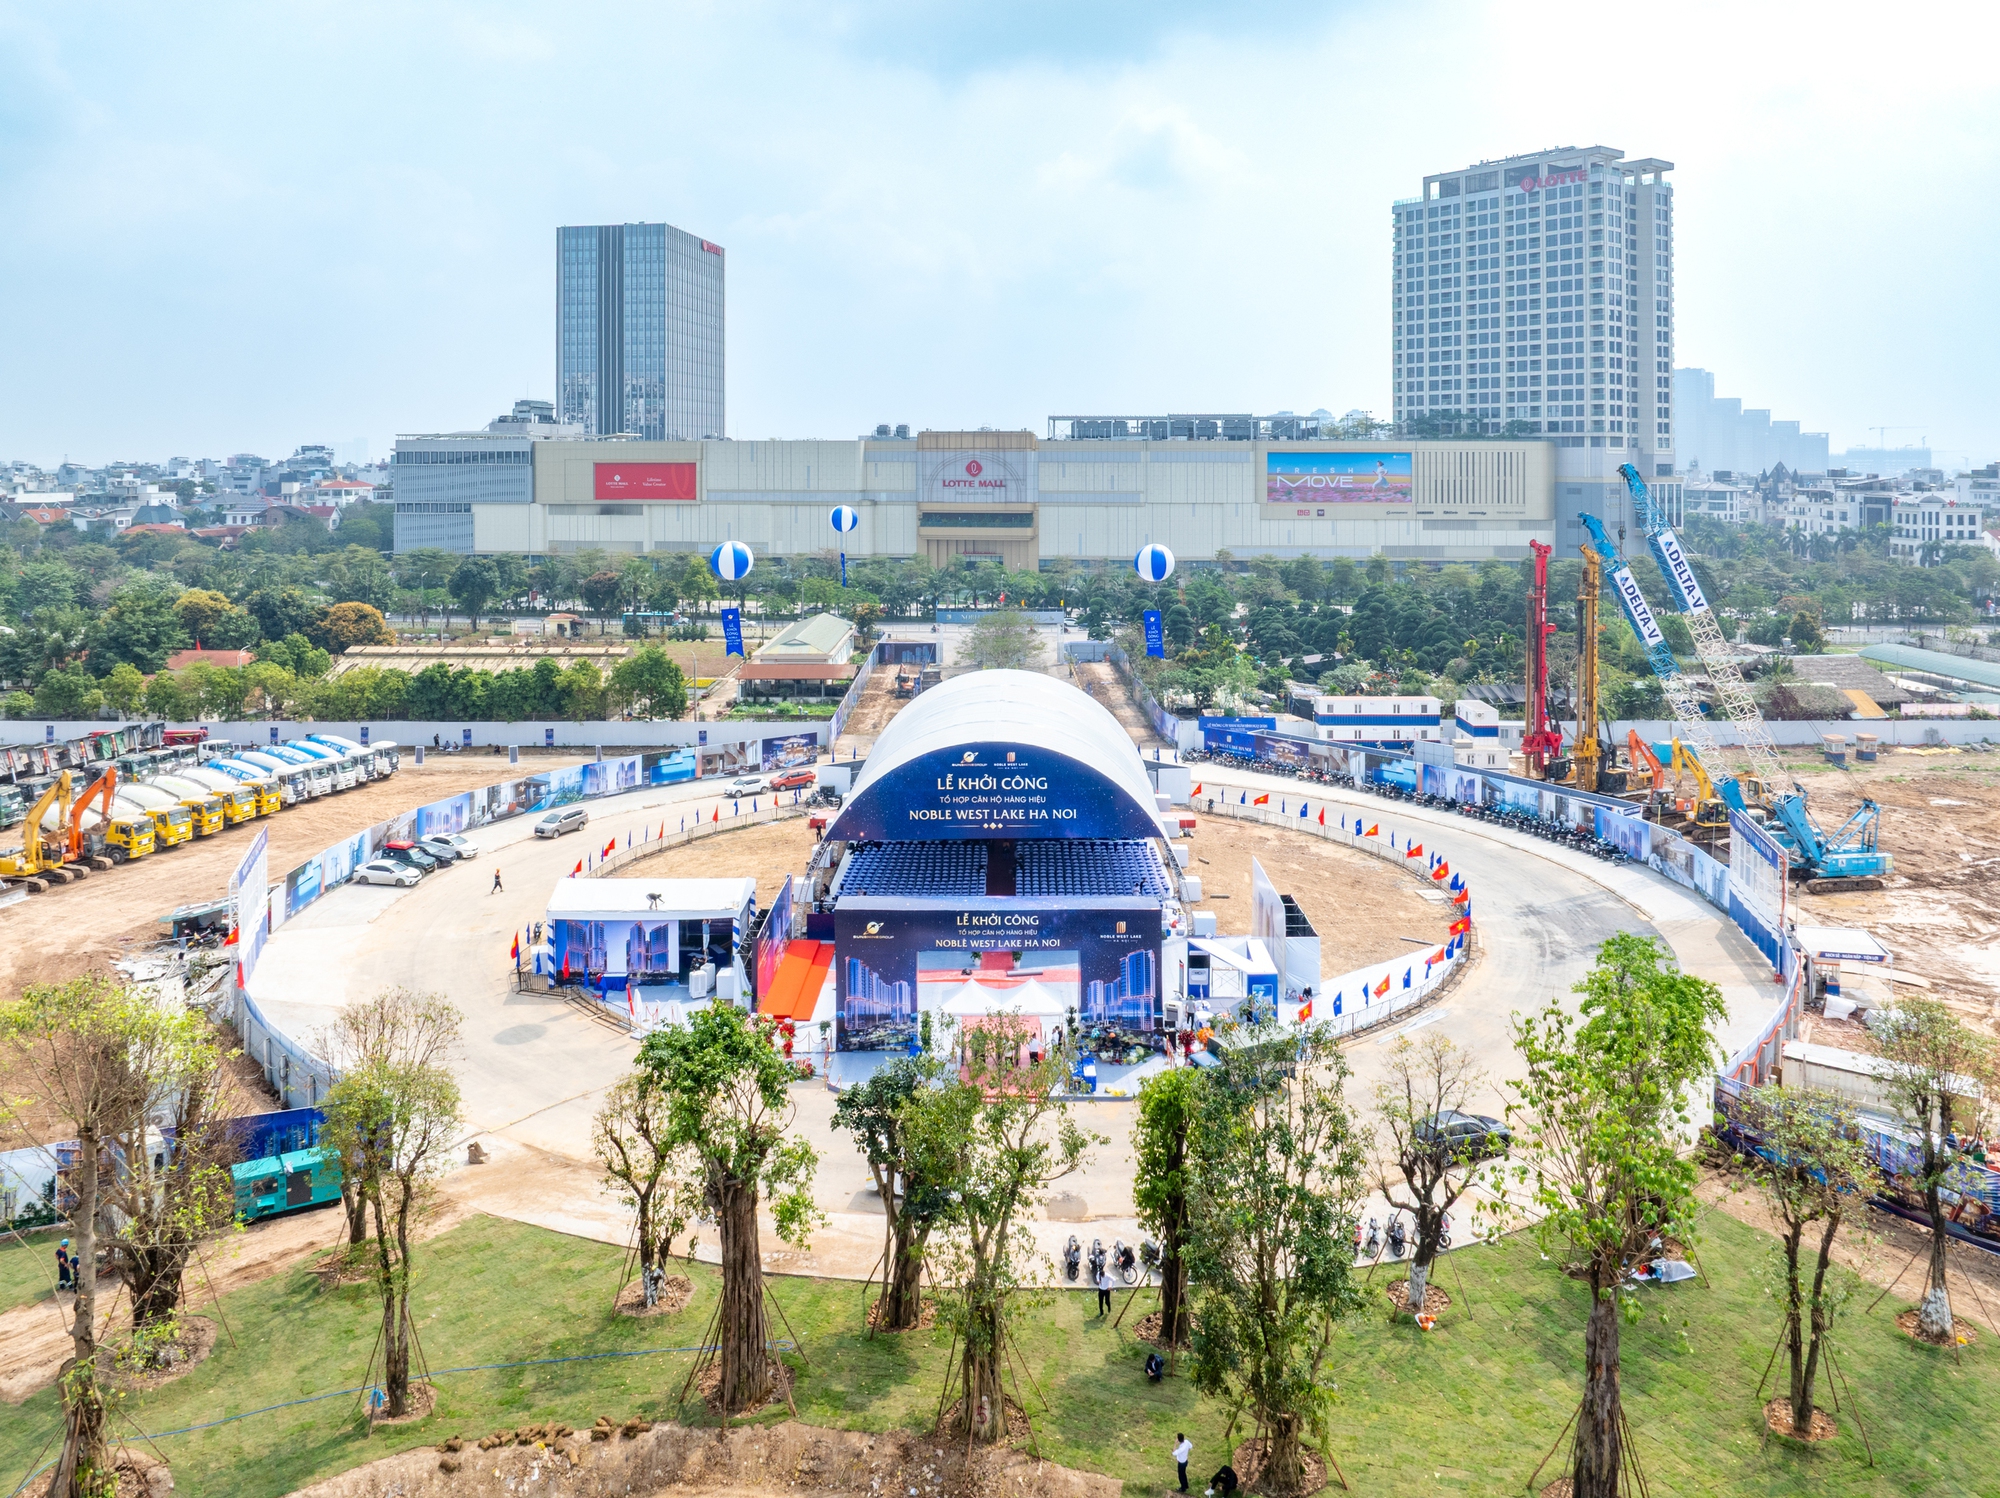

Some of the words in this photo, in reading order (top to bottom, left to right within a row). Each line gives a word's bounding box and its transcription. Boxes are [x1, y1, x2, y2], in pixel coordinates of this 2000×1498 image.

[1537, 170, 1587, 188] LOTTE
[942, 480, 975, 488] LOTTE
[978, 480, 1007, 488] MALL
[1276, 475, 1354, 488] MOVE
[1668, 549, 1705, 609] DELTA-V
[1624, 584, 1660, 639] DELTA-V
[937, 774, 954, 790] LỄ
[958, 774, 997, 790] KHỞI
[1001, 775, 1048, 790] CÔNG
[952, 796, 970, 804] HỢP
[971, 795, 988, 804] CĂN
[990, 795, 1003, 804] HỘ
[1004, 795, 1027, 804] HÀNG
[1028, 795, 1047, 804] HIỆU
[909, 809, 952, 820] NOBLE
[955, 809, 990, 820] WEST
[993, 809, 1026, 820] LAKE
[1029, 809, 1049, 819] HA
[1052, 809, 1077, 819] NOI
[956, 912, 970, 926] LỄ
[972, 913, 1001, 926] KHỞI
[1004, 913, 1039, 926] CÔNG
[995, 928, 1005, 936] HỘ
[935, 939, 968, 948] NOBLE
[970, 939, 996, 948] WEST
[998, 939, 1022, 947] LAKE
[1024, 939, 1039, 947] HA
[1042, 938, 1060, 947] NOI
